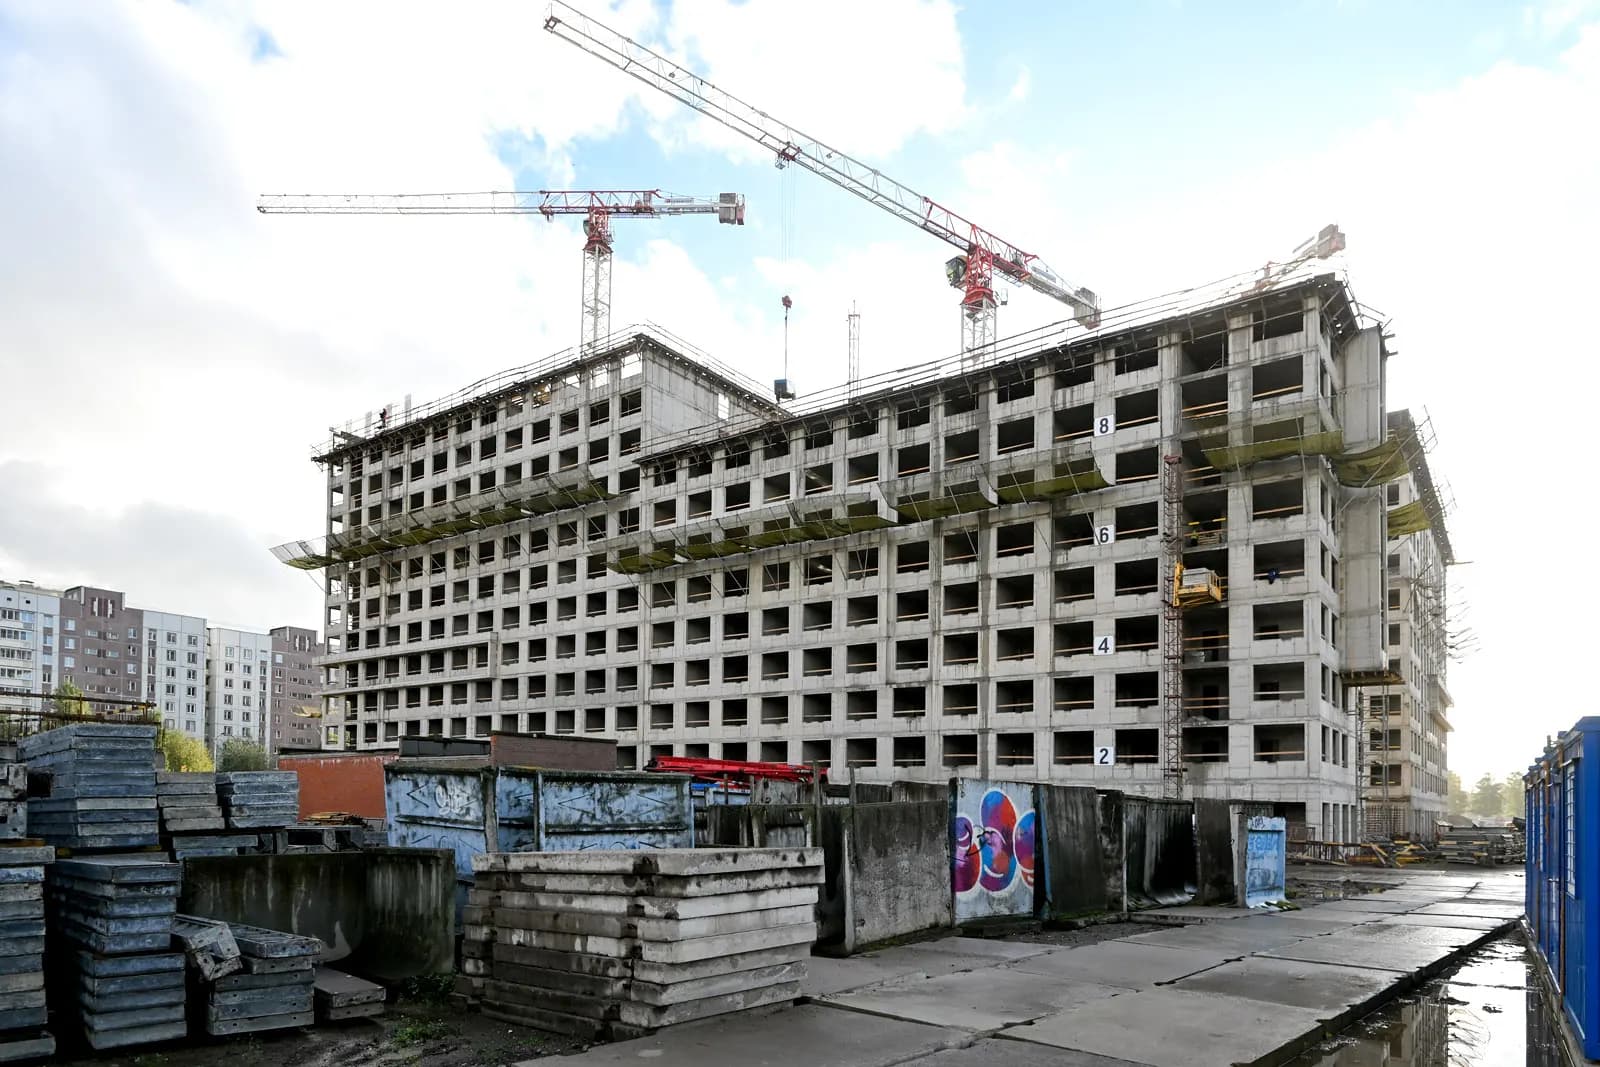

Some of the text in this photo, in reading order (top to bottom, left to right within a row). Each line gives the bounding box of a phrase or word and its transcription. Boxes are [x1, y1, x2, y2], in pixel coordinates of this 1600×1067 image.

[1099, 418, 1109, 434] 8
[1099, 527, 1109, 543] 6
[1098, 637, 1110, 653] 4
[1099, 748, 1109, 764] 2
